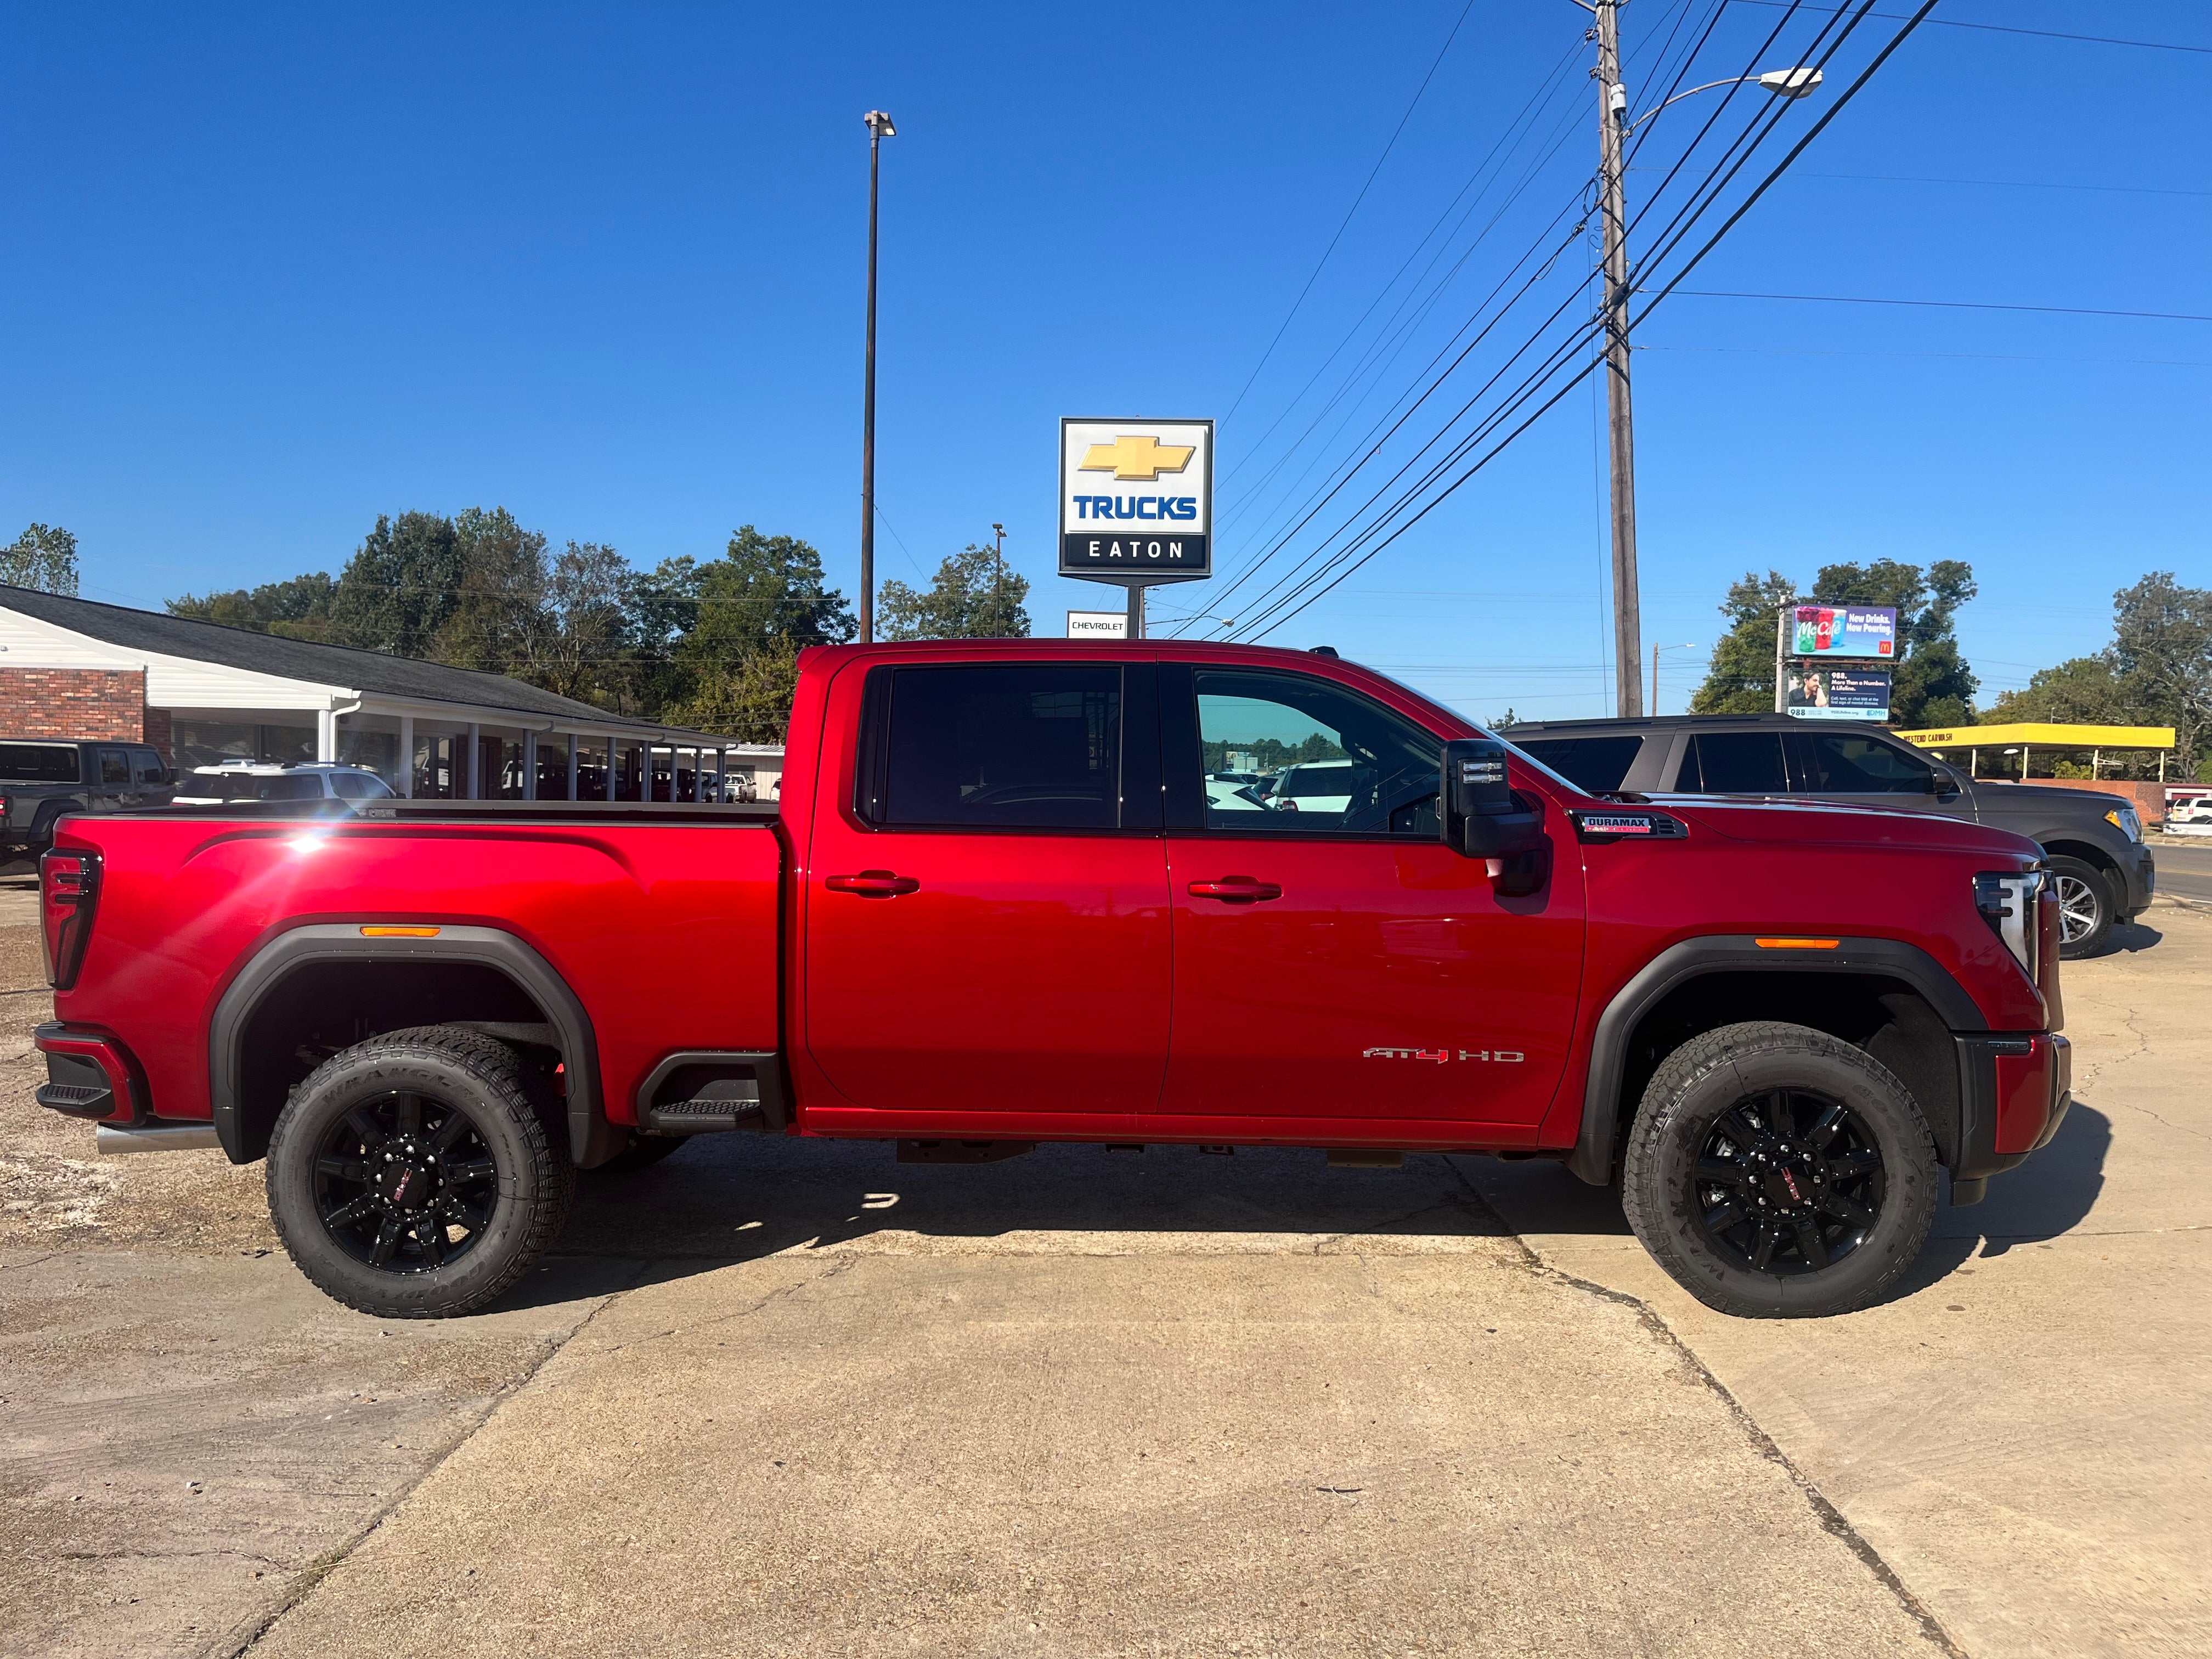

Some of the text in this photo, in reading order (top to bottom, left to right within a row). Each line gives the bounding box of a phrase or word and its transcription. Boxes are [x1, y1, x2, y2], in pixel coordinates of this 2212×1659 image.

[1073, 495, 1196, 520] TRUCKS
[1089, 541, 1182, 558] EATON
[1849, 613, 1891, 624] New Drinks.
[1072, 622, 1124, 630] CHEVROLET
[1847, 623, 1892, 636] Now Pouring.
[1588, 818, 1645, 827] DURAMAX
[1363, 1047, 1524, 1064] AT4 HD
